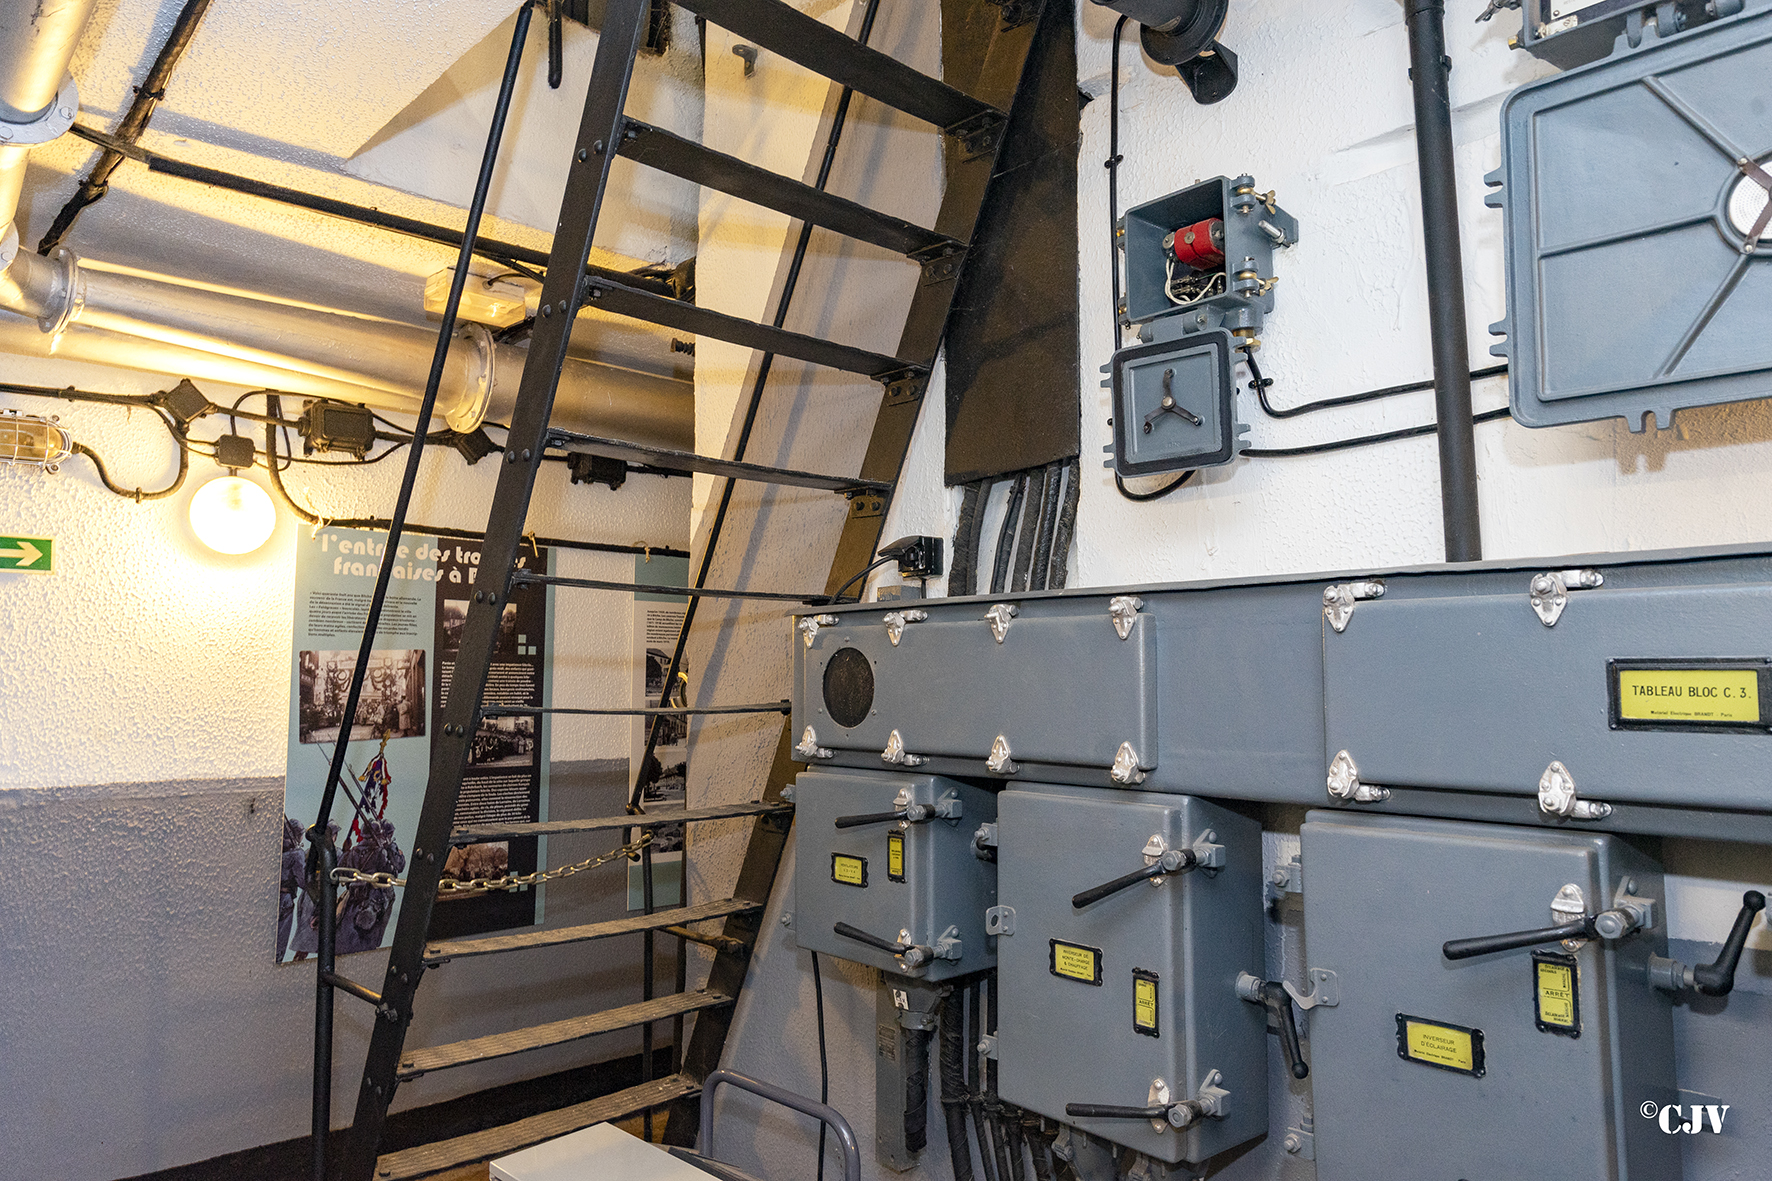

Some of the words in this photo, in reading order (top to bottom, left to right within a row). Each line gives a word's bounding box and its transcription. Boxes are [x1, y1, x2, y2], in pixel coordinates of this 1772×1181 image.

[322, 534, 409, 558] l'entre
[416, 543, 450, 562] des
[456, 546, 526, 569] tros
[334, 556, 444, 582] franaises
[450, 566, 462, 584] à
[1632, 685, 1682, 696] TABLEAU
[1688, 686, 1718, 698] BLOC
[1423, 1035, 1454, 1045] INVERSEUR
